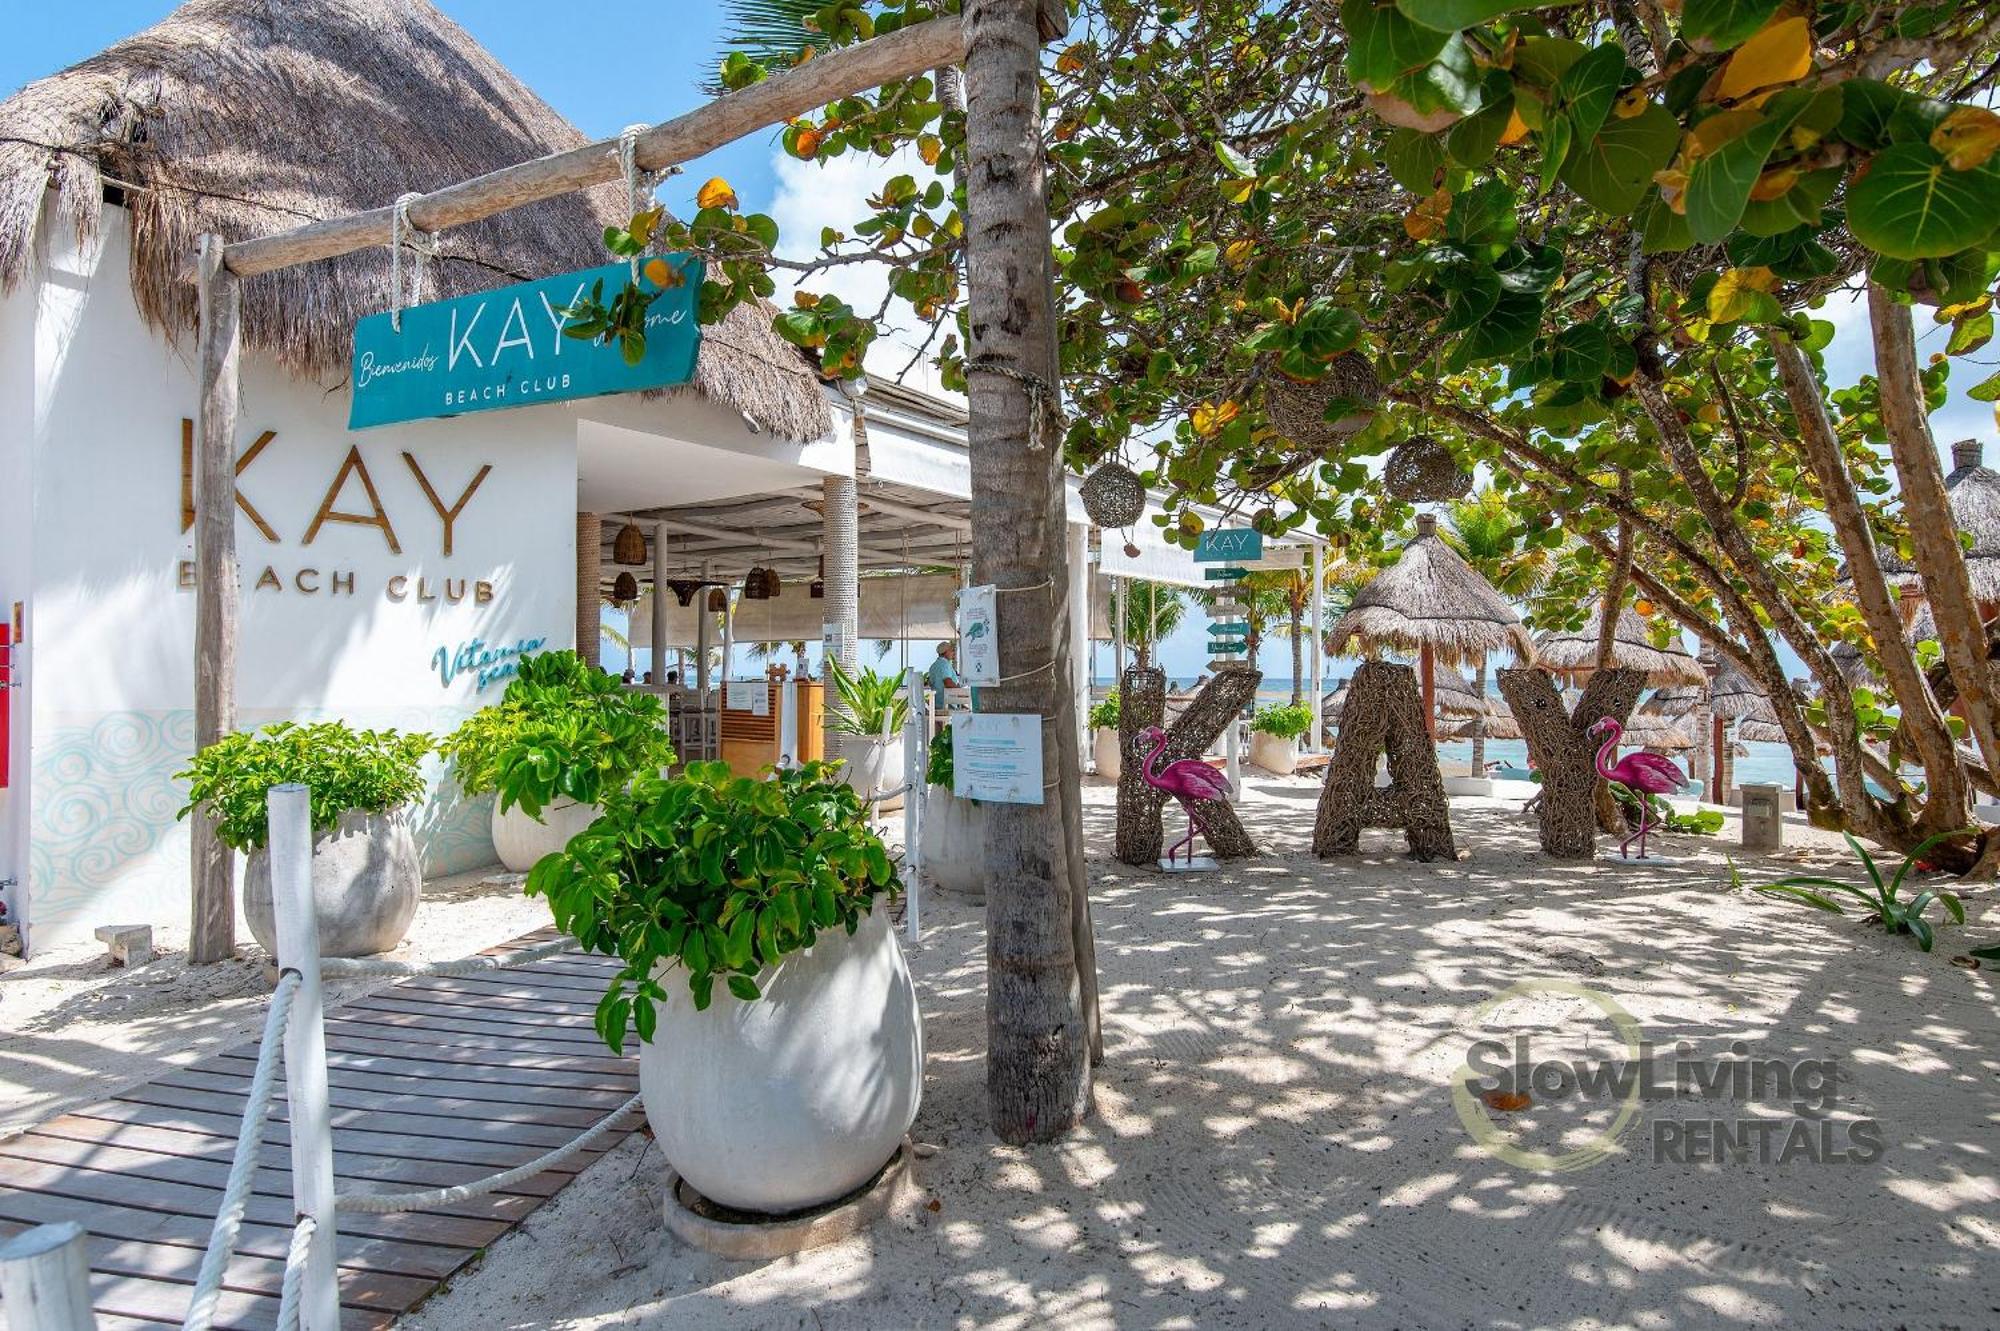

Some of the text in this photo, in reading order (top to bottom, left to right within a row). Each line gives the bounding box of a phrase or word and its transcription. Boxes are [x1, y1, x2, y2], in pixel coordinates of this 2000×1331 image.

[358, 344, 439, 388] Bienvenidos
[449, 282, 586, 372] KAY
[445, 374, 572, 405] BEACH CLUB
[180, 417, 493, 557] KAY
[1205, 533, 1249, 552] KAY
[179, 560, 495, 602] BACH CLUB
[1115, 662, 1649, 865] KAY
